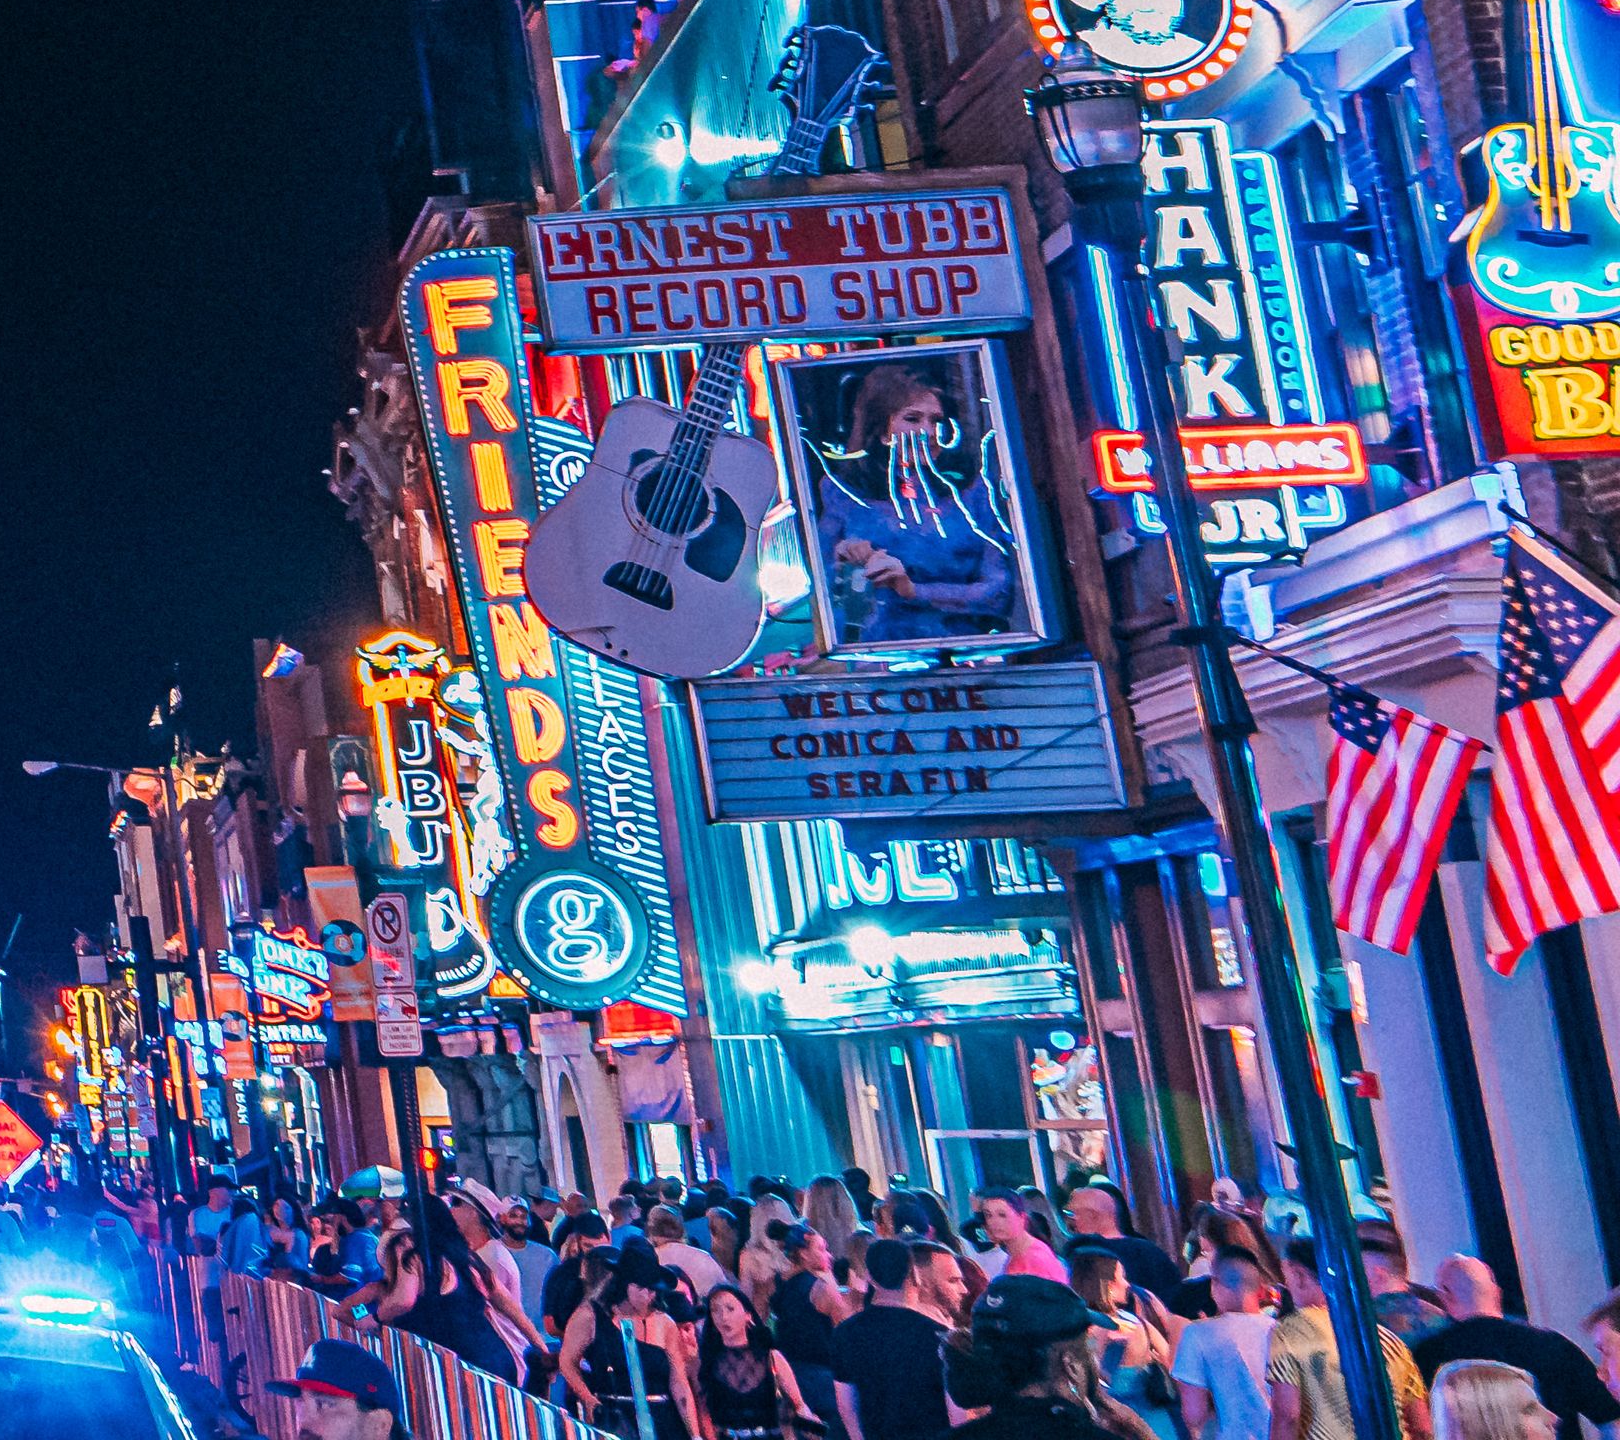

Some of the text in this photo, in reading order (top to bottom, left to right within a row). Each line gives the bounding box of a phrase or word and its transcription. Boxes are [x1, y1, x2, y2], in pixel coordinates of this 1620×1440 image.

[543, 196, 1005, 275] ERNEST TUBB
[1142, 132, 1254, 419] HANK
[587, 263, 979, 335] RECORD SHOP
[562, 456, 586, 484] IN
[1116, 435, 1353, 476] WLLIAMS
[424, 277, 579, 849] FRIENDS
[779, 685, 991, 719] WELCOME
[588, 660, 641, 856] LACES
[769, 724, 1022, 761] CONICA AND
[806, 766, 990, 799] SERAFIN
[253, 931, 330, 982] ONKY
[254, 970, 313, 1009] ONK
[257, 1024, 328, 1043] ENTRAL
